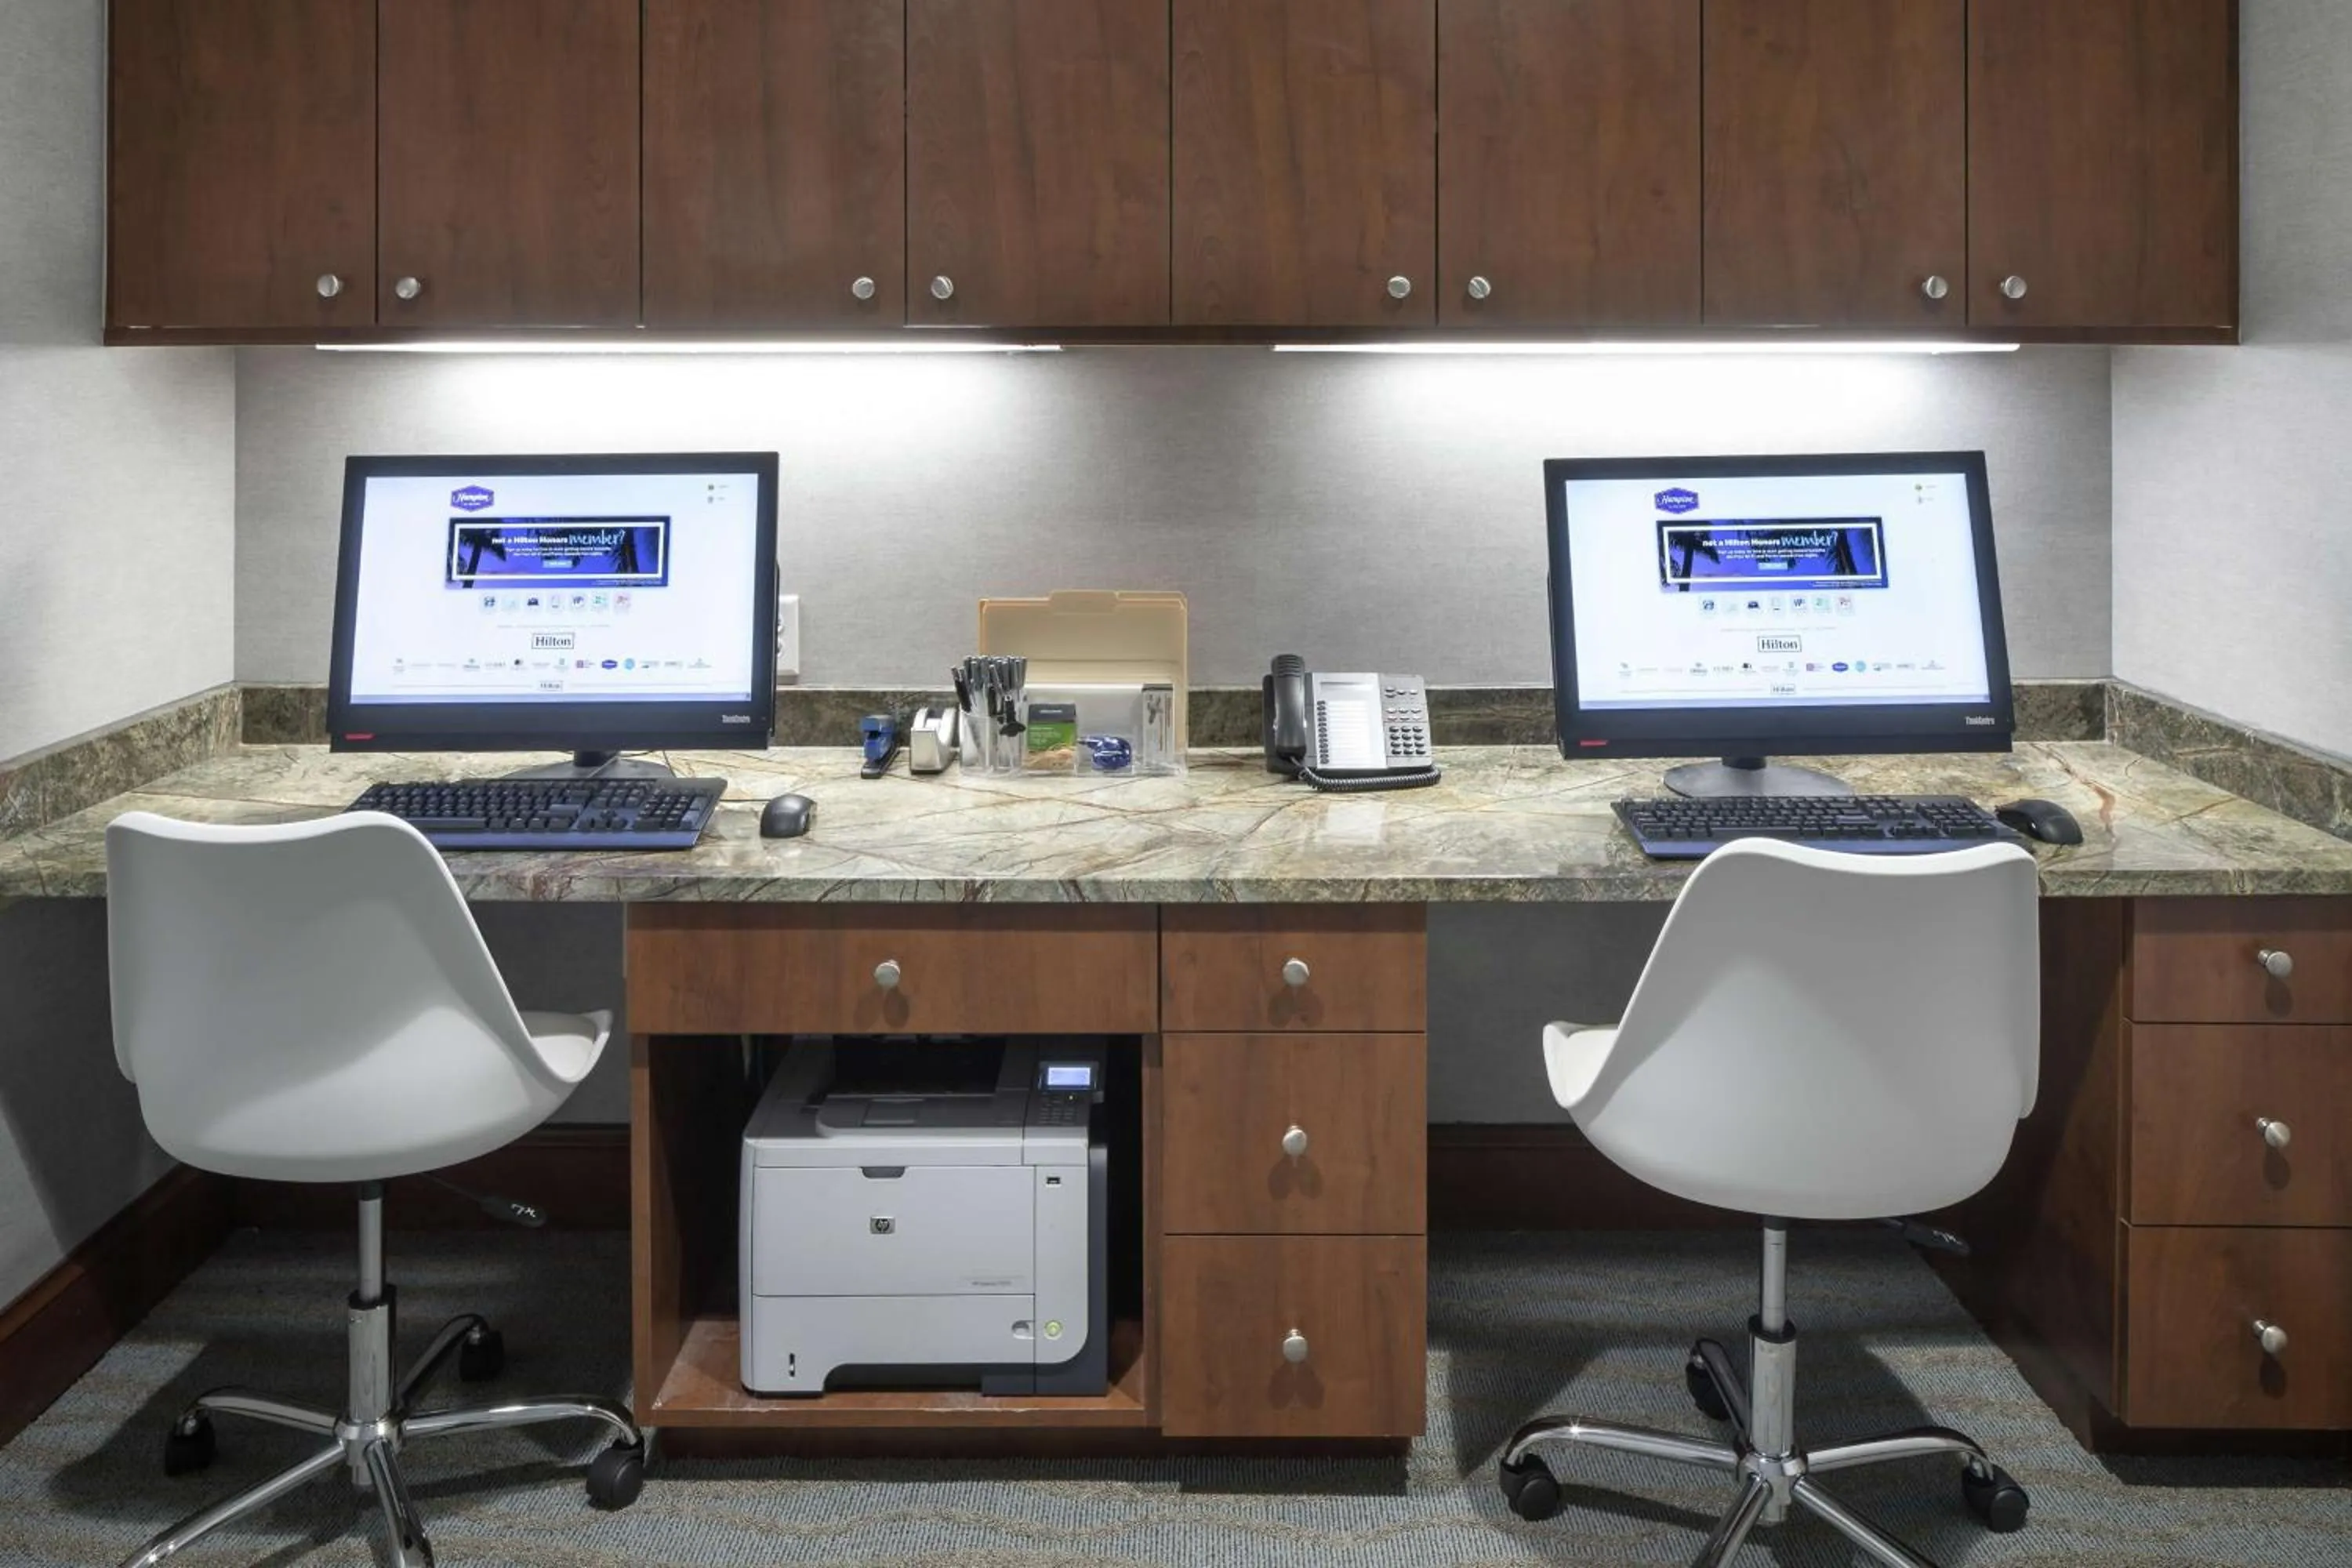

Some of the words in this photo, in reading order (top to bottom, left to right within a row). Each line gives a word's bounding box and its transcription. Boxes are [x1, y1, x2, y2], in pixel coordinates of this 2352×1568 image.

[568, 529, 626, 545] member?
[1725, 538, 1751, 546] Hilton
[1751, 538, 1780, 546] Honors
[1781, 529, 1838, 546] member?
[535, 636, 572, 647] Hilton
[1761, 639, 1798, 650] Hilton
